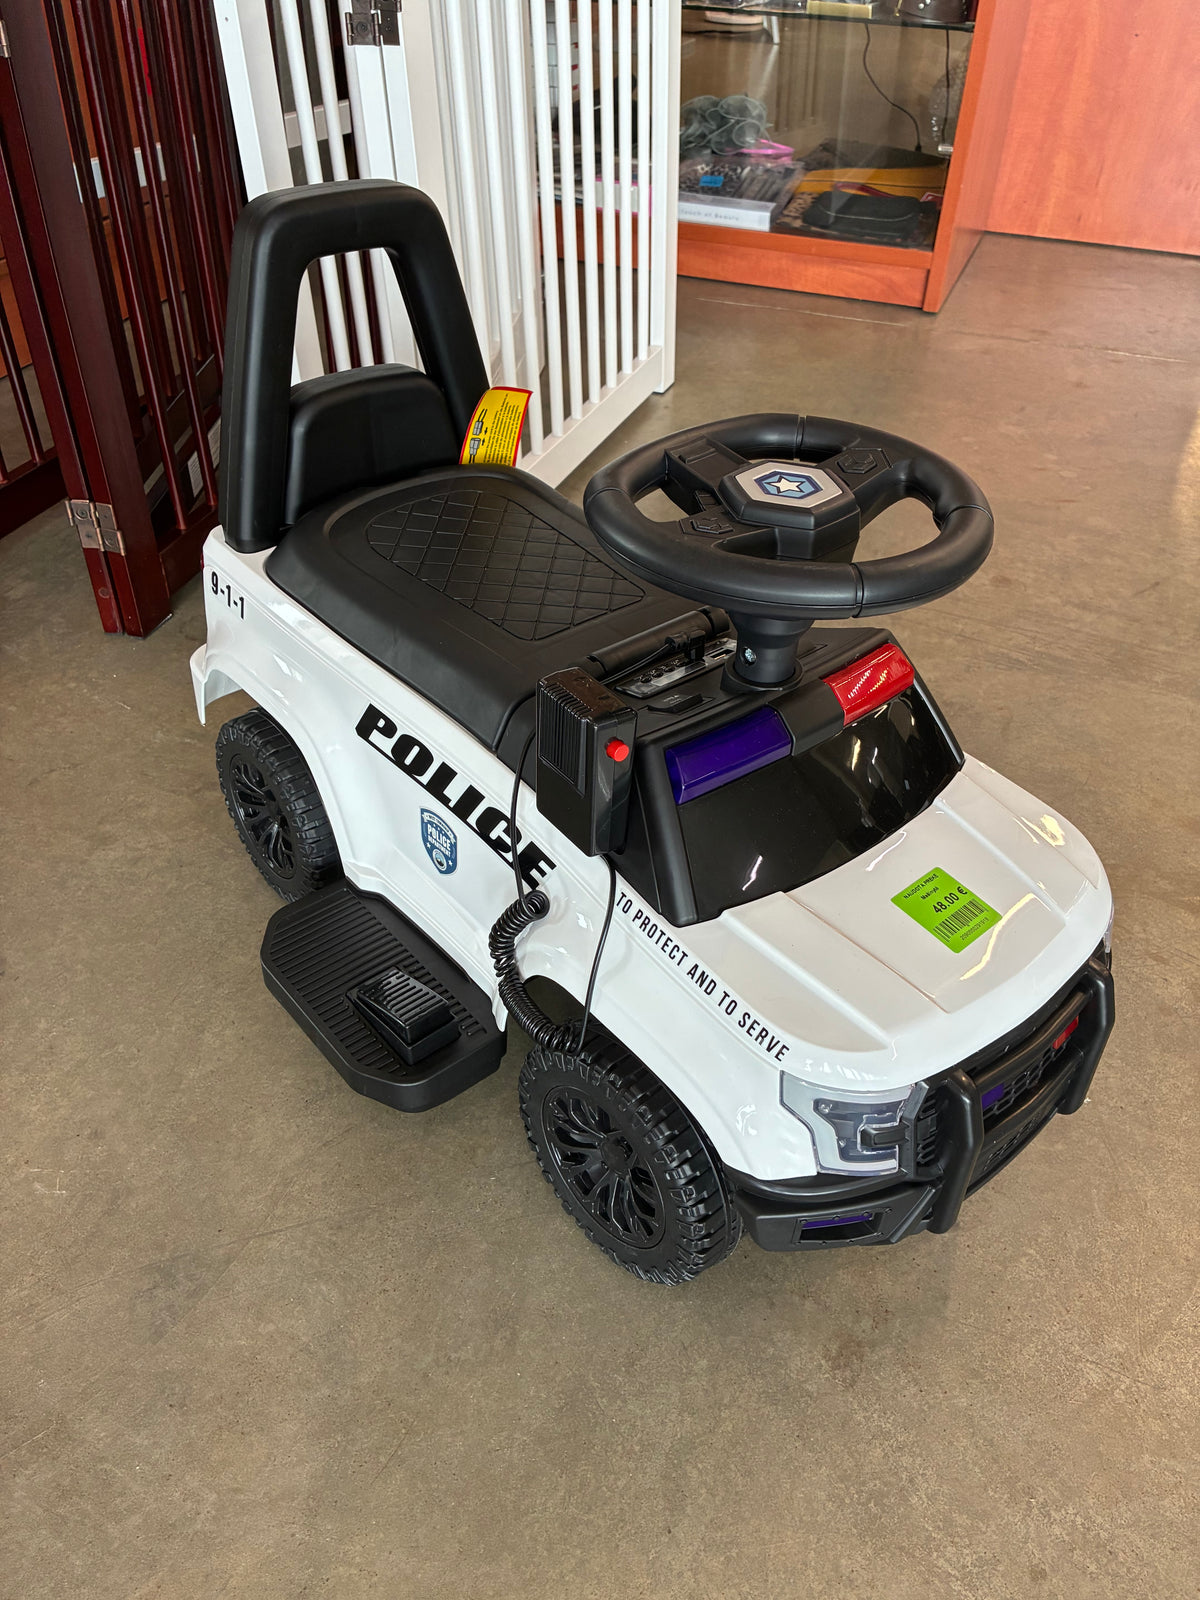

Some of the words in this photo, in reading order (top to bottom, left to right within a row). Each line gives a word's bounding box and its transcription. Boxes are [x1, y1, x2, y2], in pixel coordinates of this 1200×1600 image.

[211, 571, 245, 620] 9-1-1
[355, 703, 557, 891] POLICE
[427, 823, 451, 851] POLICE
[932, 892, 960, 914] 48.00
[956, 886, 968, 896] €
[616, 891, 633, 914] TO
[632, 909, 688, 966] PROTECT
[686, 963, 717, 996] AND
[718, 991, 738, 1016] TO
[737, 1012, 790, 1062] SERVE
